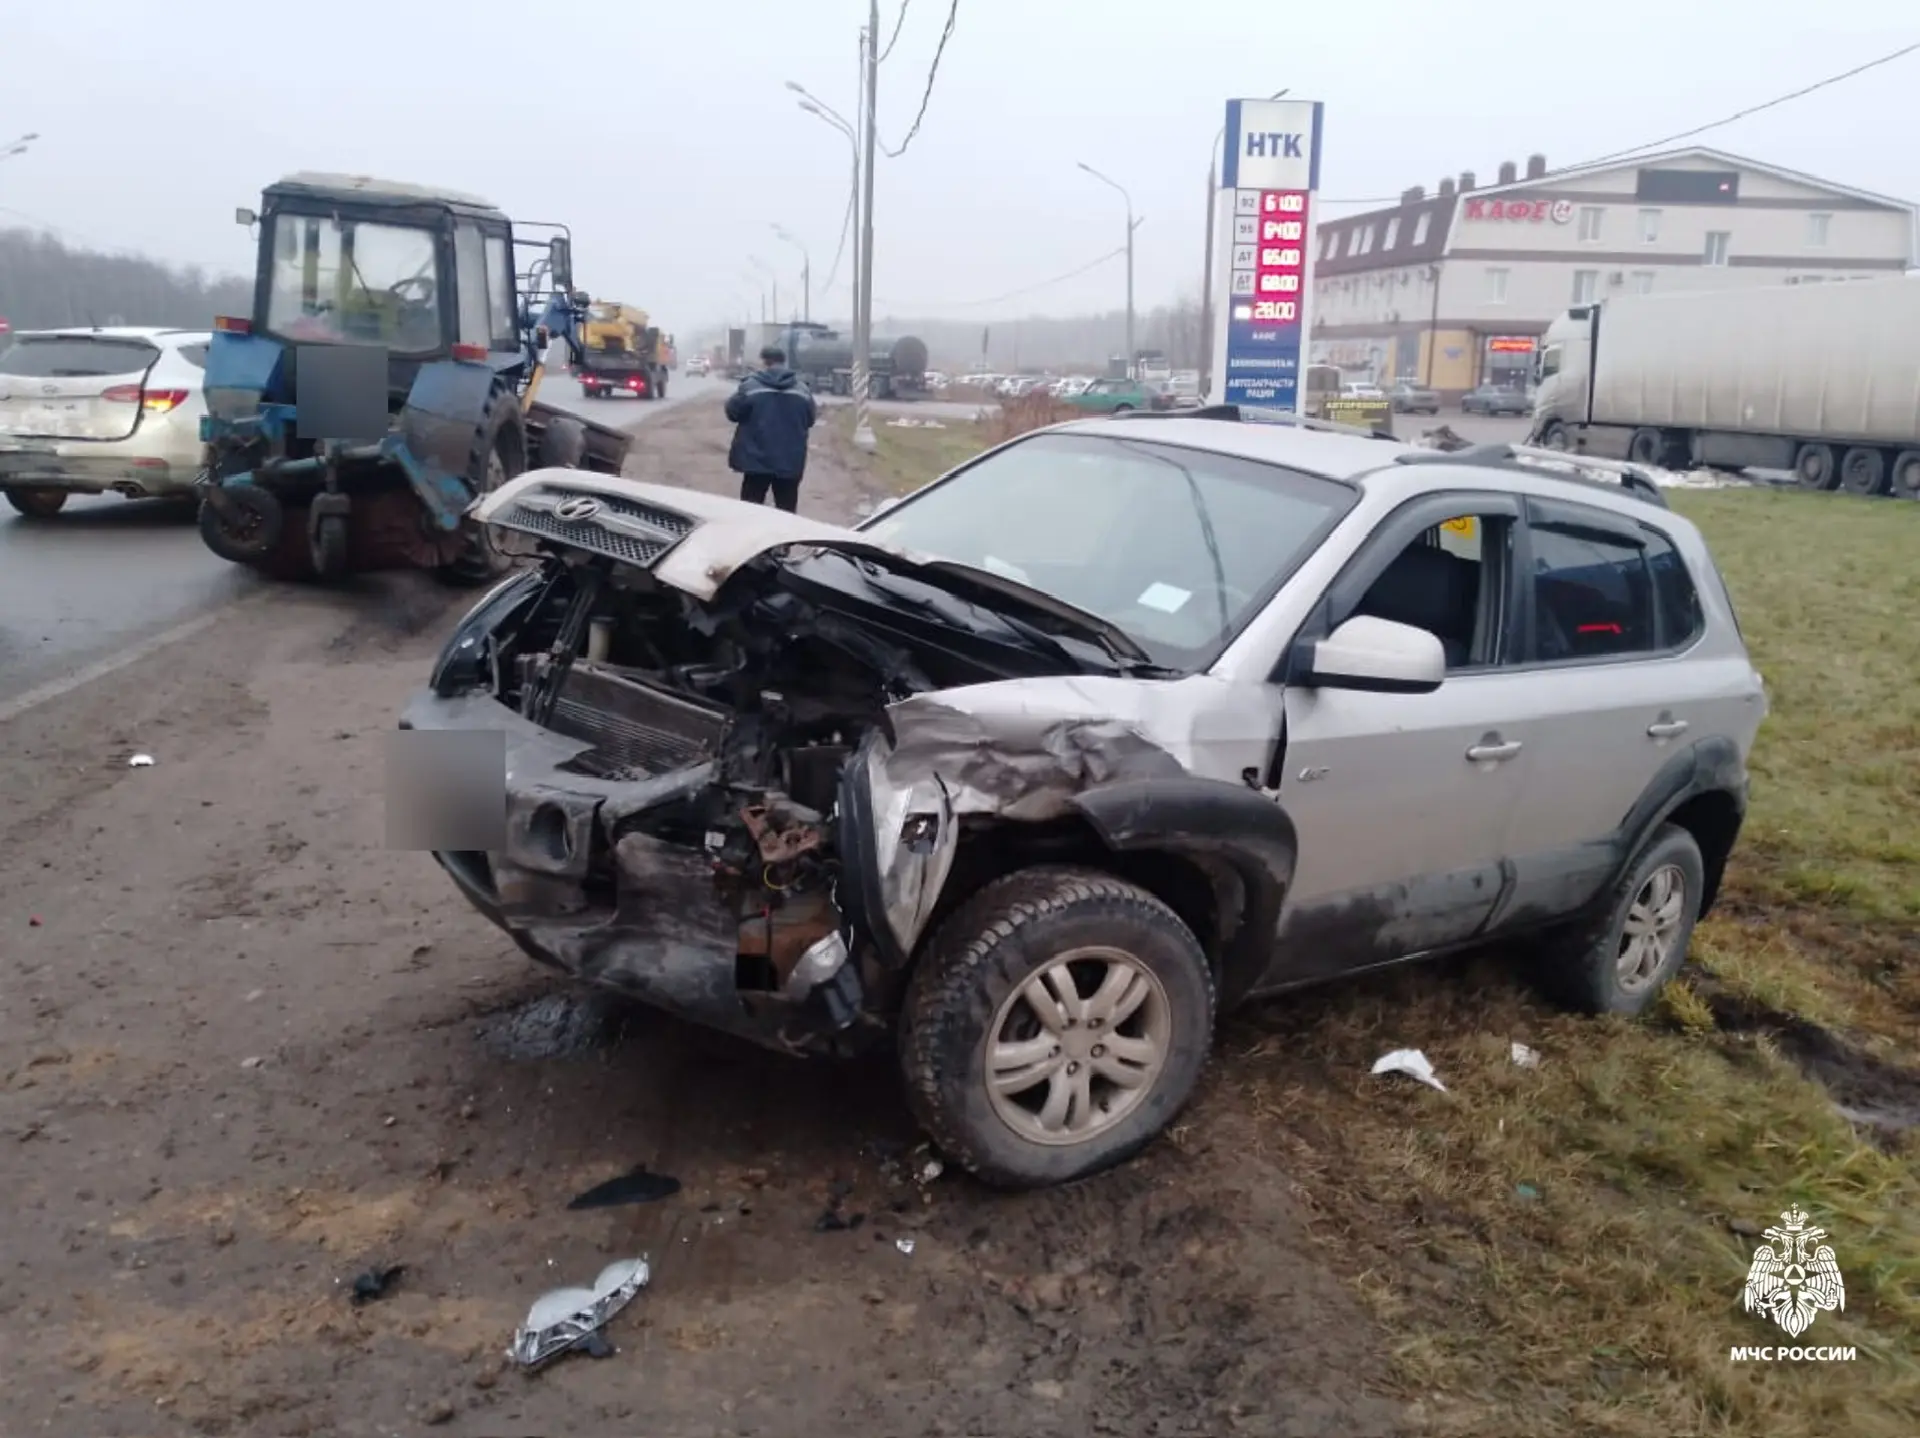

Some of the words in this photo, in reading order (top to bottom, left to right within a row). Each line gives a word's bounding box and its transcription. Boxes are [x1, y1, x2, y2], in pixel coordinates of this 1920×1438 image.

[1246, 131, 1304, 159] НТК
[1241, 197, 1255, 209] 92
[1465, 199, 1550, 221] КАФЕ
[1228, 377, 1295, 389] АВТОЗАПЧАСТИ
